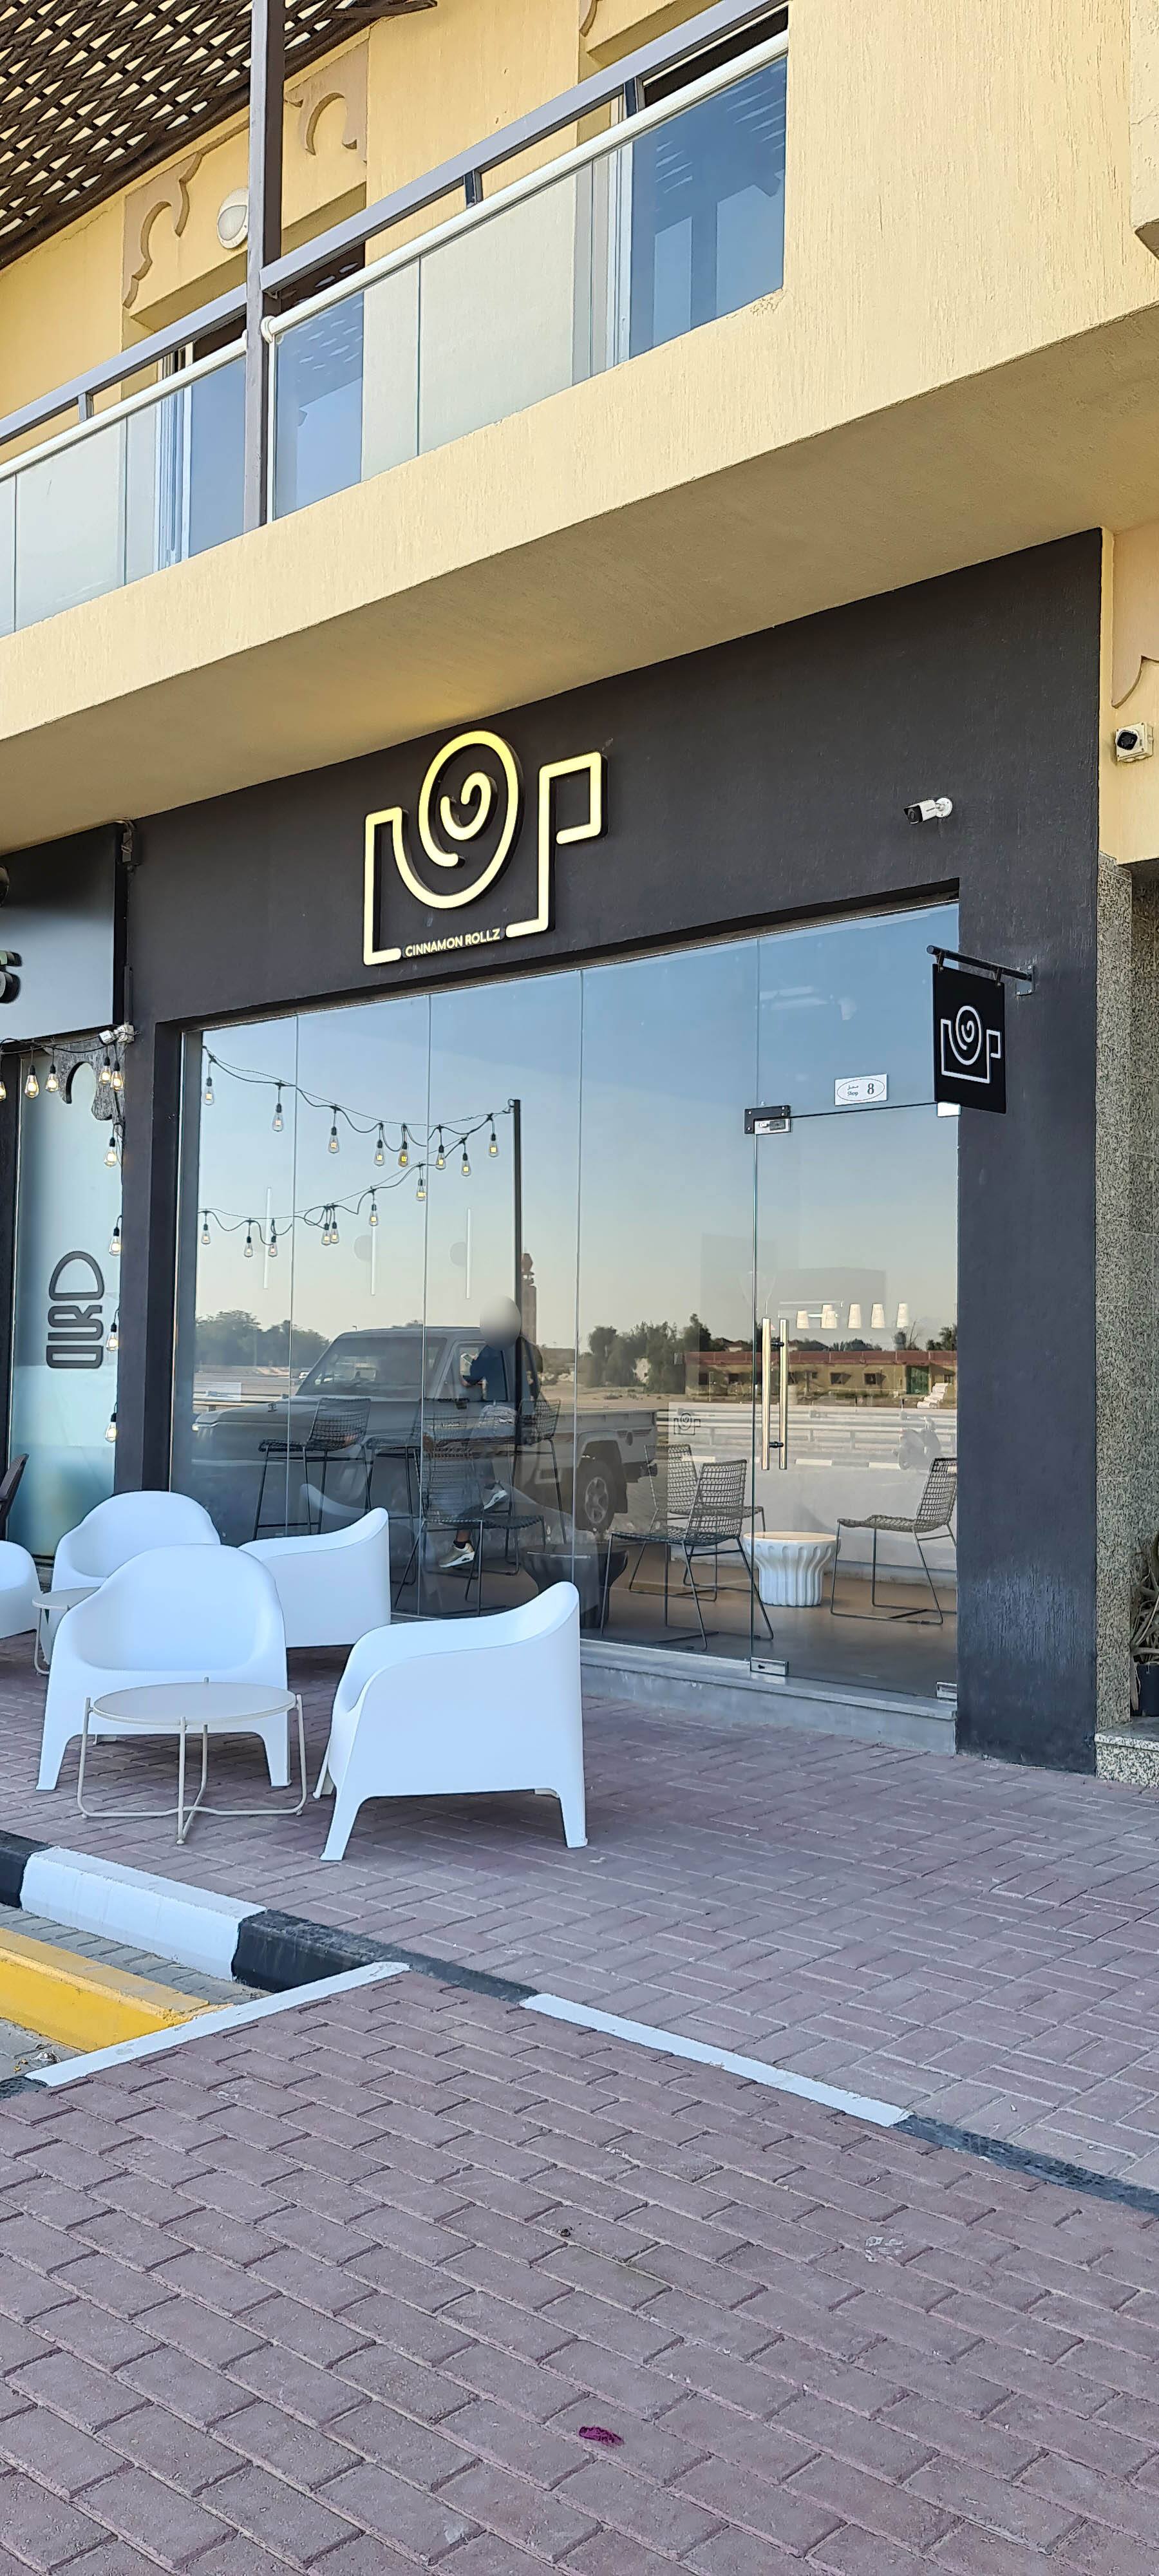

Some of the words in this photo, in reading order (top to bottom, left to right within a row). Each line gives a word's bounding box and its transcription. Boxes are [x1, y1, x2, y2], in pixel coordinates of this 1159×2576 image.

[405, 935, 463, 957] CINNAMON
[465, 928, 500, 945] ROLLZ
[867, 1083, 874, 1095] 8
